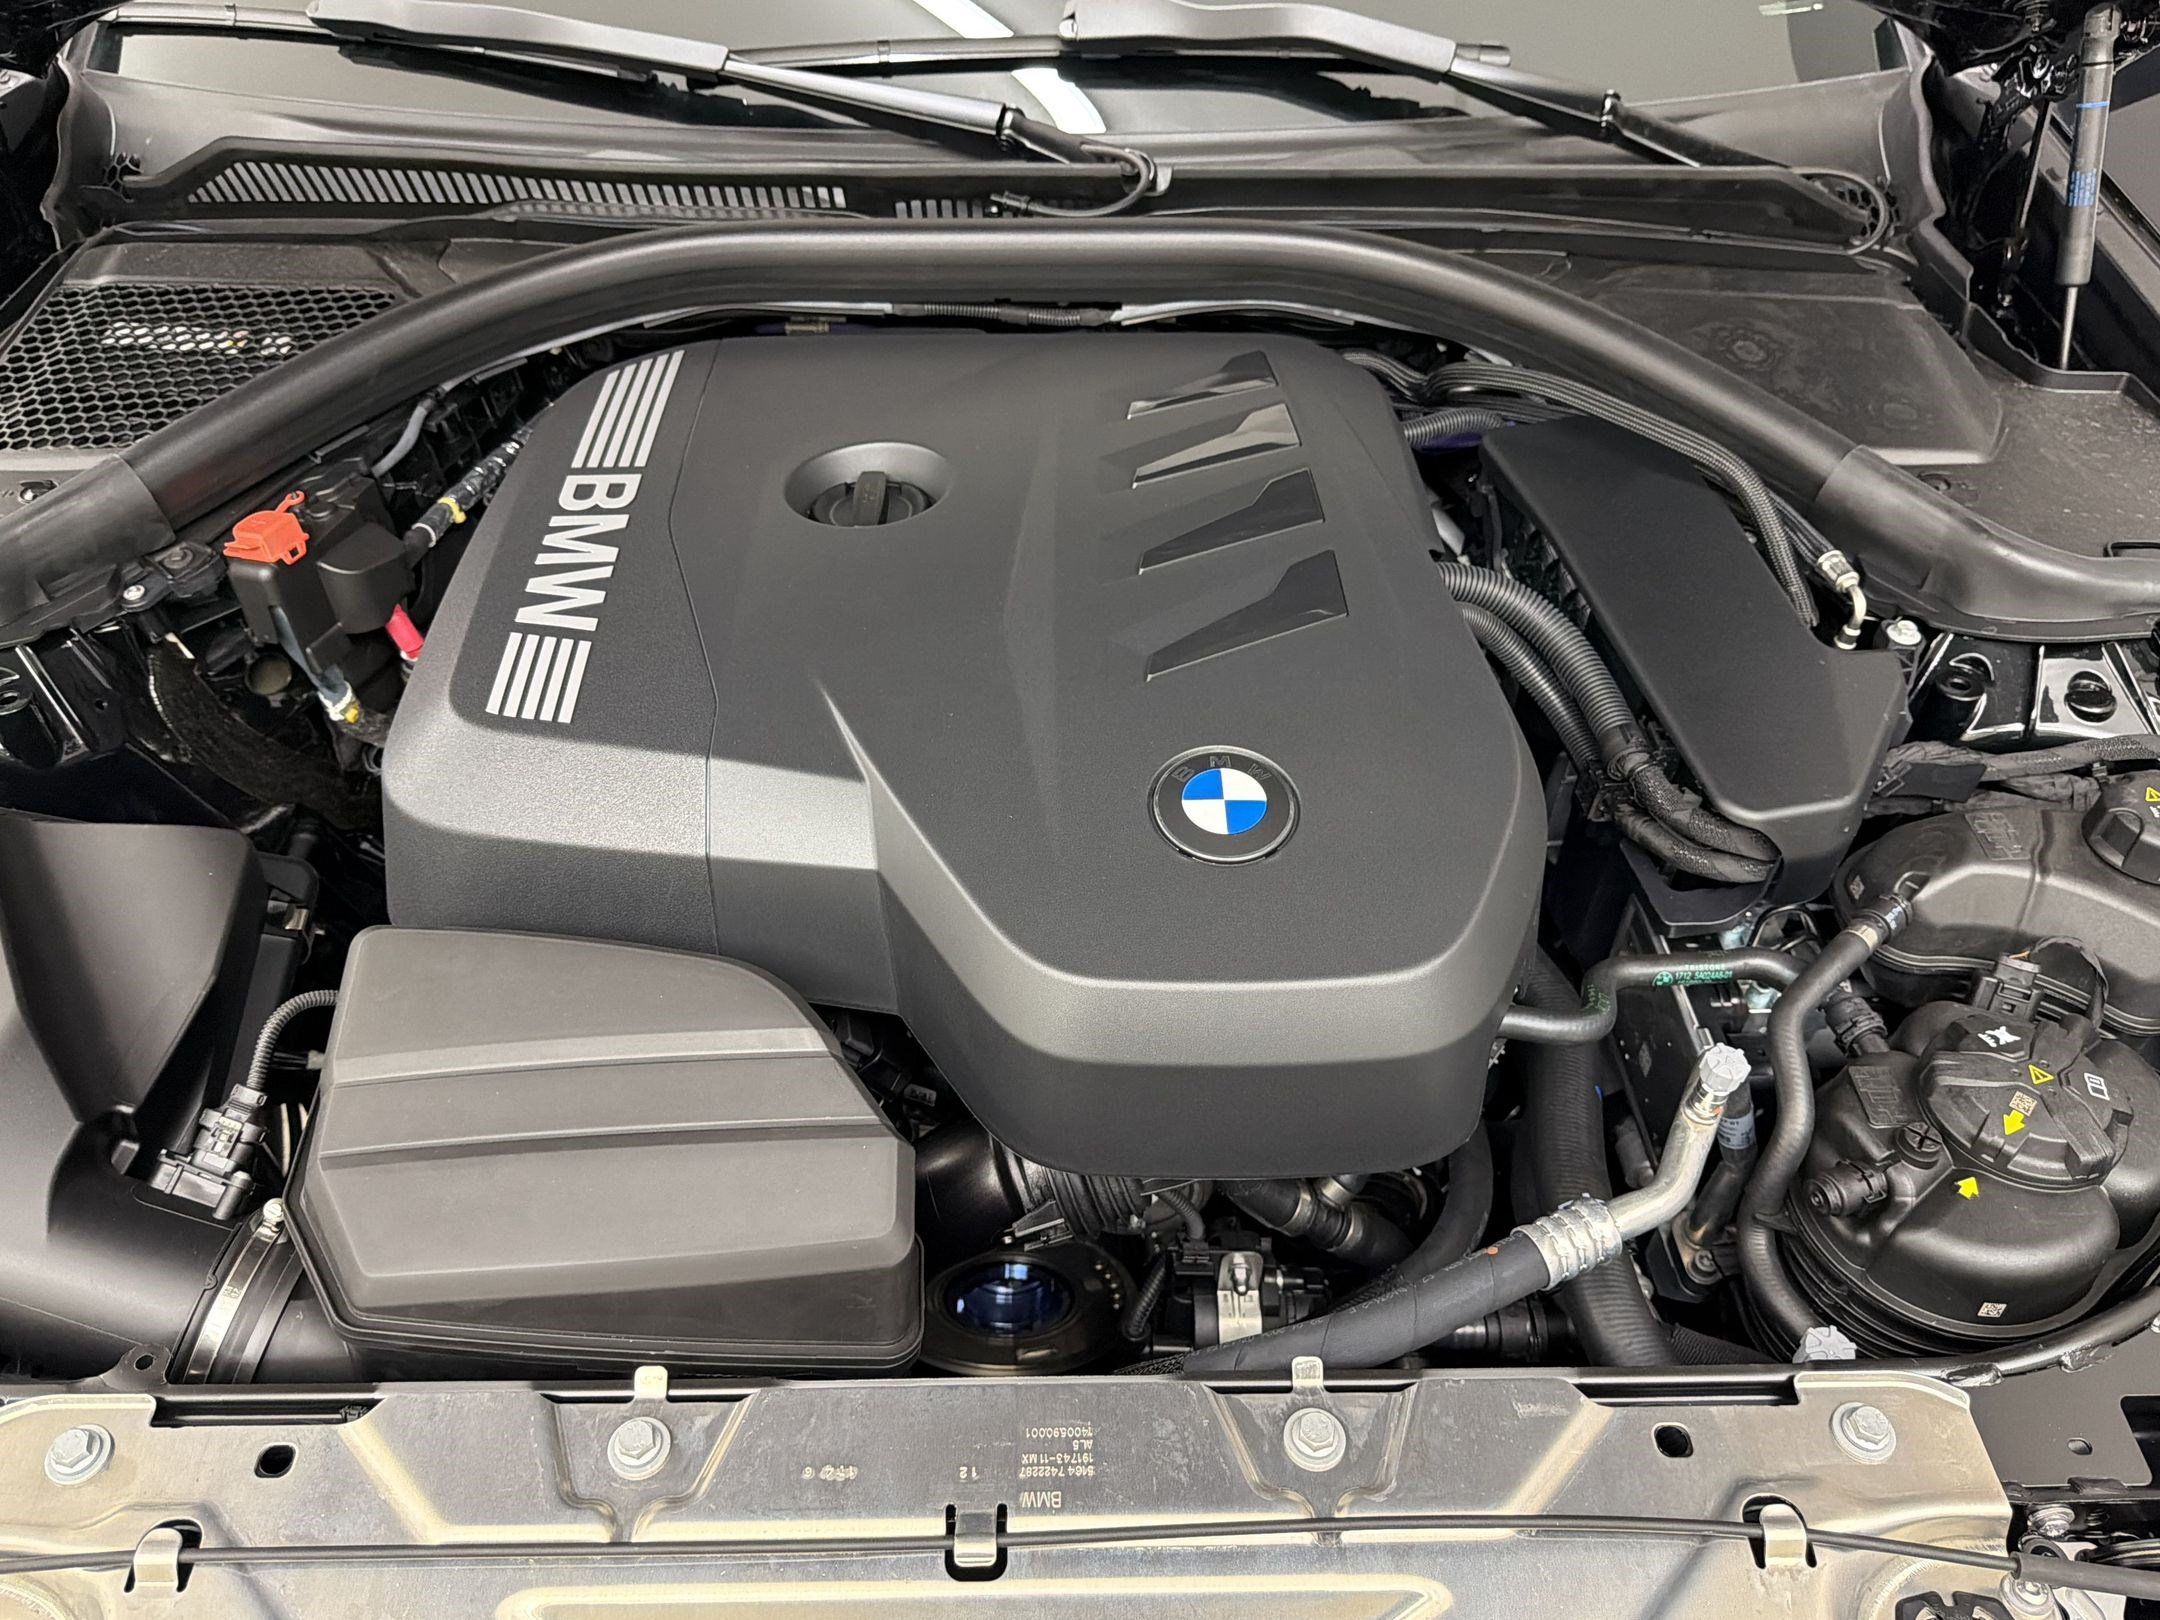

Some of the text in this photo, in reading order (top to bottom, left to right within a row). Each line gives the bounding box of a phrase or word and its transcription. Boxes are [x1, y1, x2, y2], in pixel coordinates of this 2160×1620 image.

[514, 474, 643, 631] BMW
[1171, 755, 1272, 783] BMW
[1019, 1491, 1062, 1508] BMW
